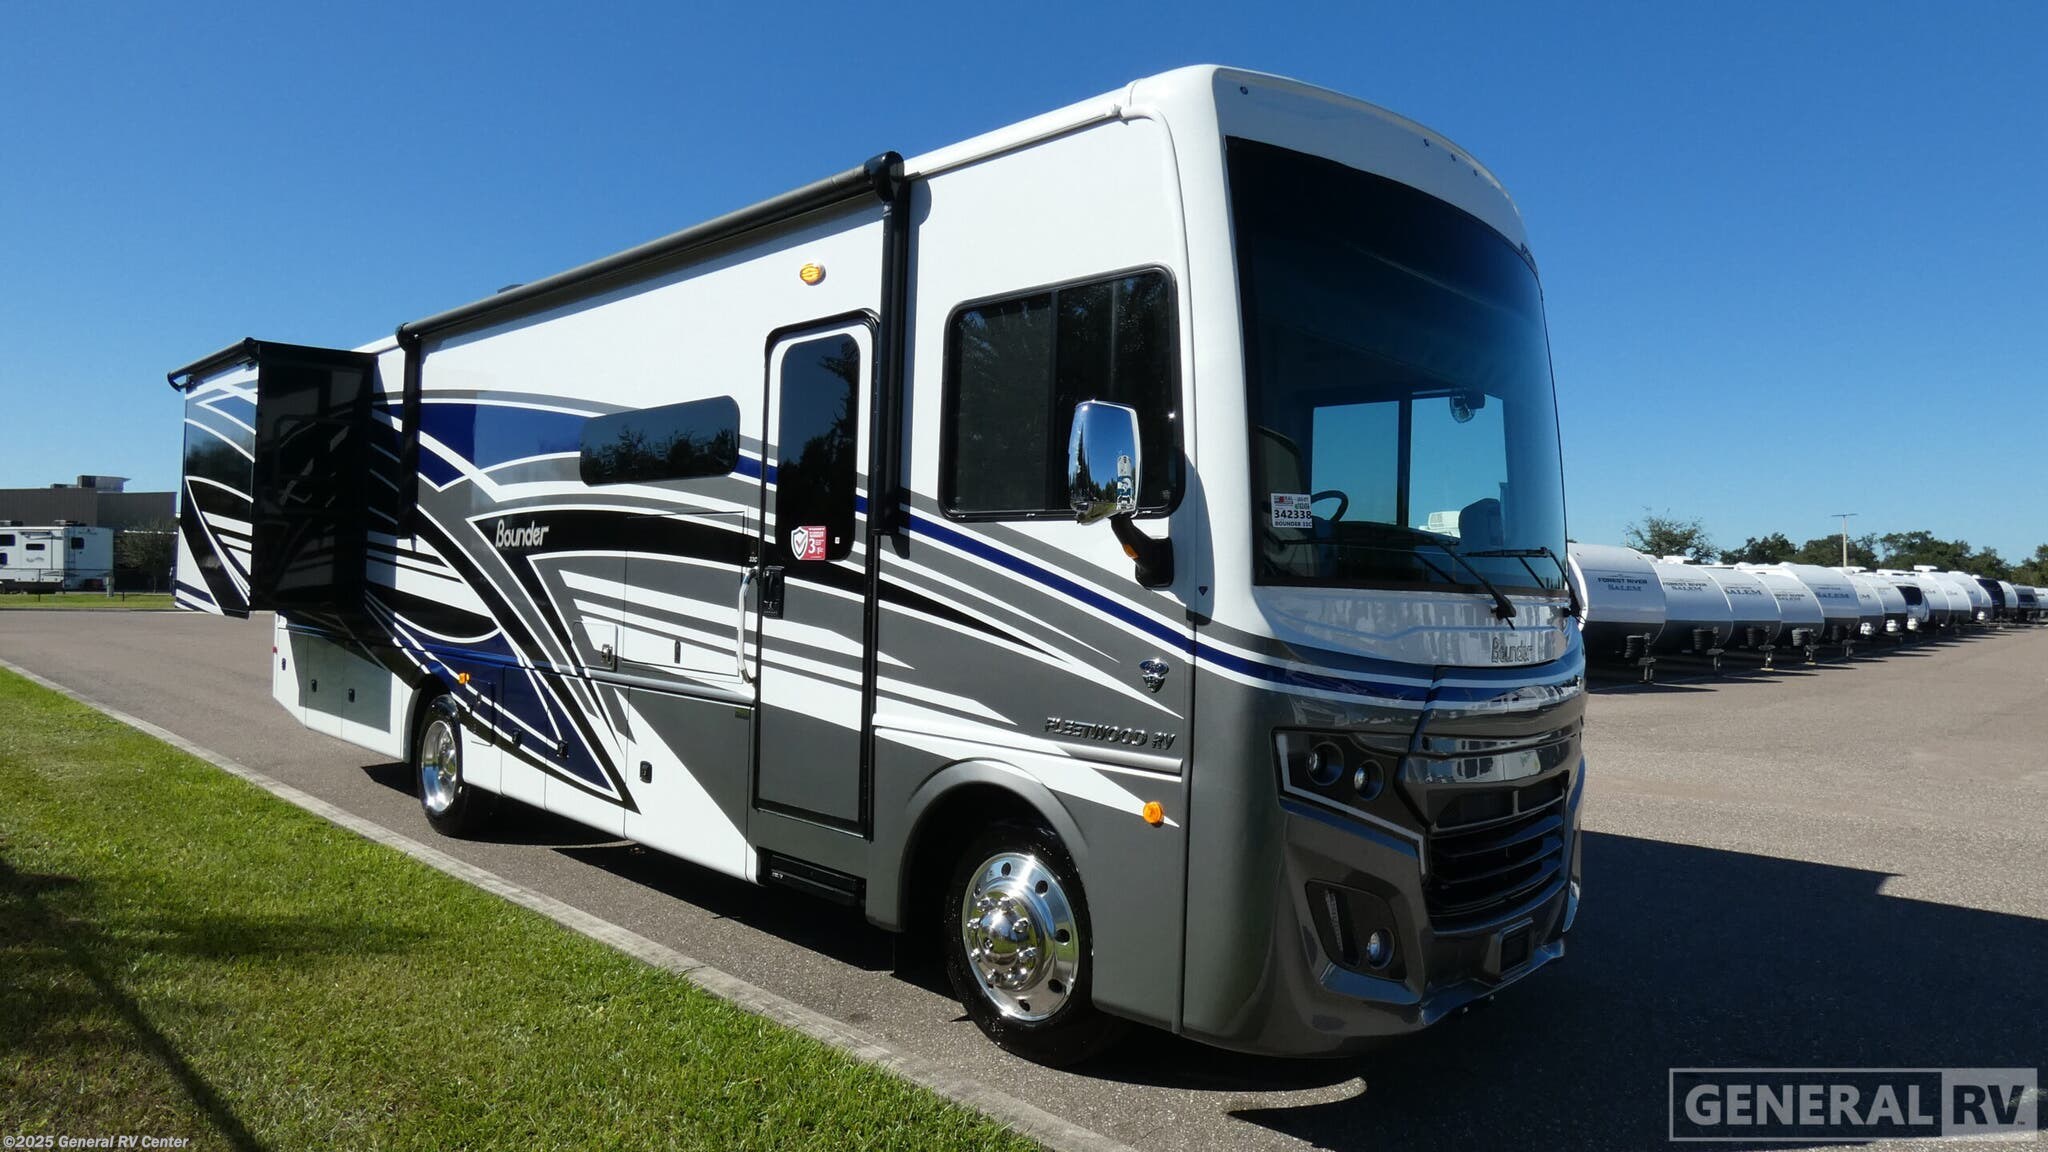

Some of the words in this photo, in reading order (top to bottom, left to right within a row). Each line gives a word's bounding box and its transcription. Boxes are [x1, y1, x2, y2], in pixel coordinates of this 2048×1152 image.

[1274, 510, 1312, 519] 342338
[495, 519, 549, 548] Bounder
[1608, 584, 1642, 592] SALEM
[1815, 591, 1849, 599] SALEM
[1491, 636, 1533, 663] Bounder
[1044, 717, 1148, 746] FLEETWOOD
[1152, 732, 1176, 750] RV
